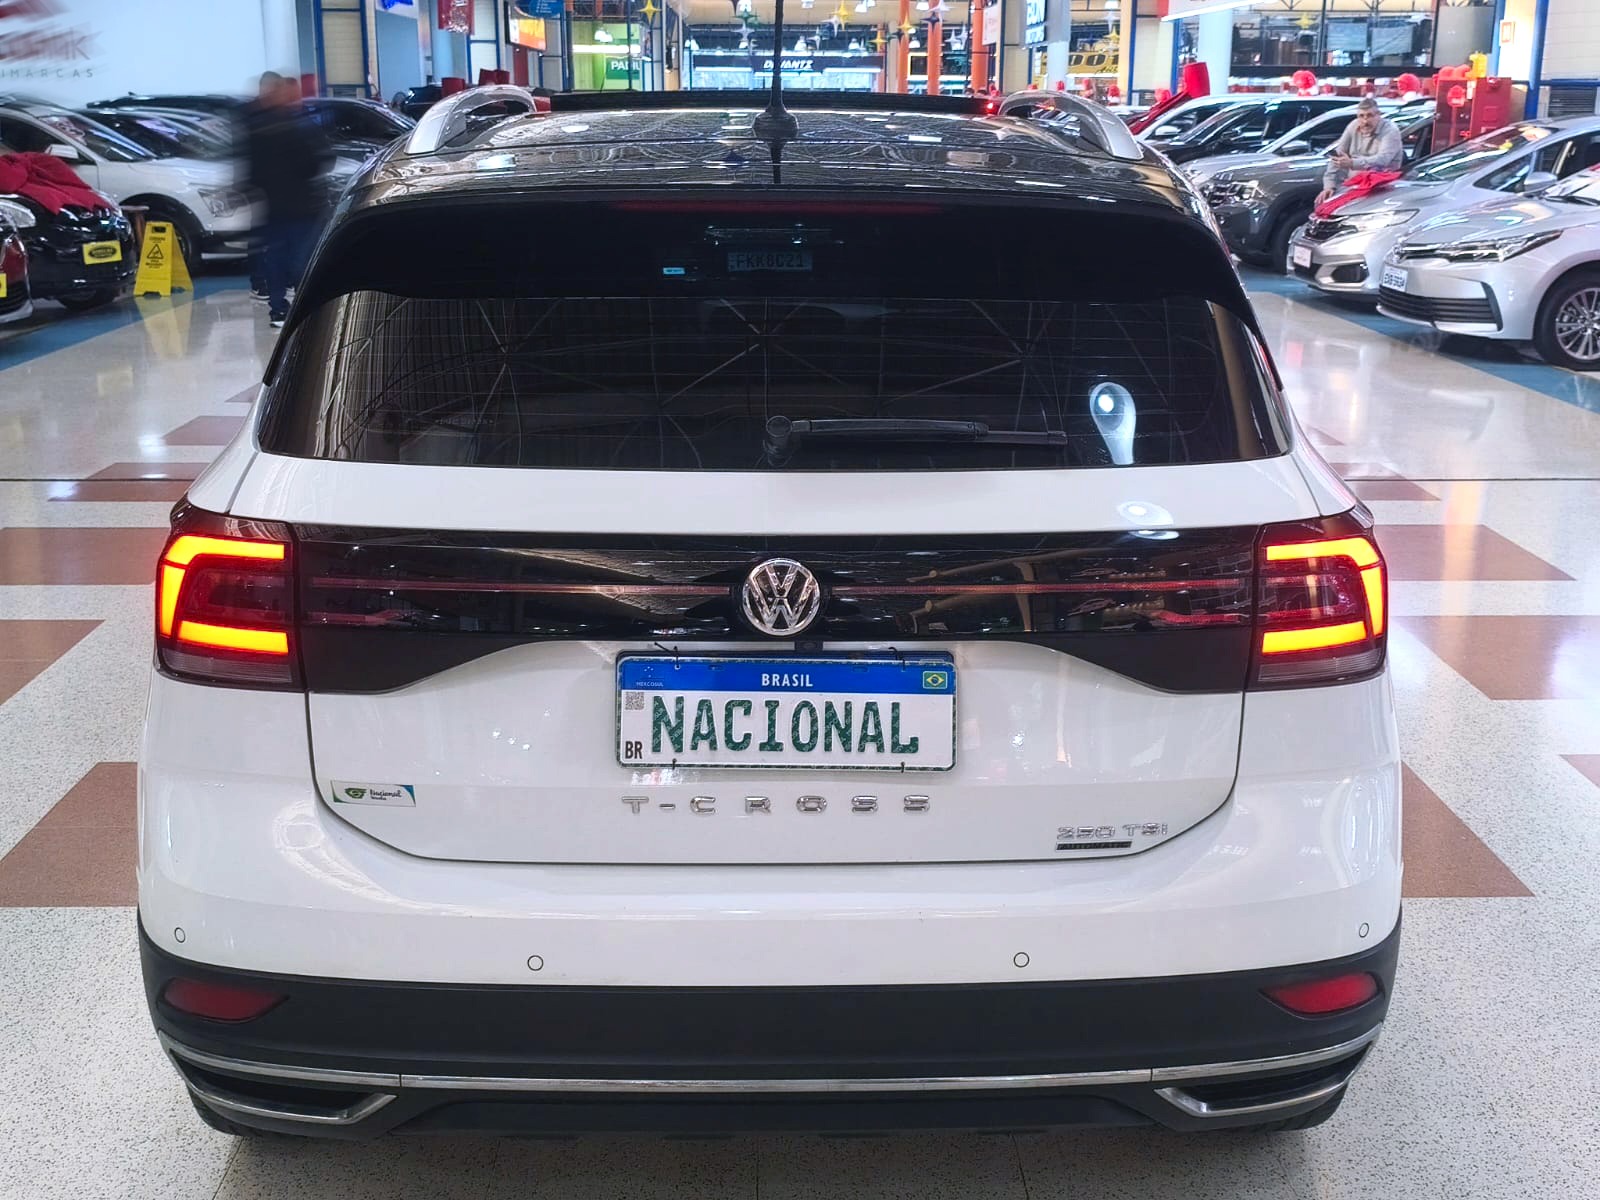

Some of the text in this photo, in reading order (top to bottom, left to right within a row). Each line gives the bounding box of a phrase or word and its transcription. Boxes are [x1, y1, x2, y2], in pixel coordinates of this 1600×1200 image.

[761, 673, 813, 687] BRASIL
[651, 695, 919, 754] NACIONAL
[625, 741, 643, 759] BR
[622, 795, 932, 814] T-CROSS
[1056, 826, 1116, 840] 250
